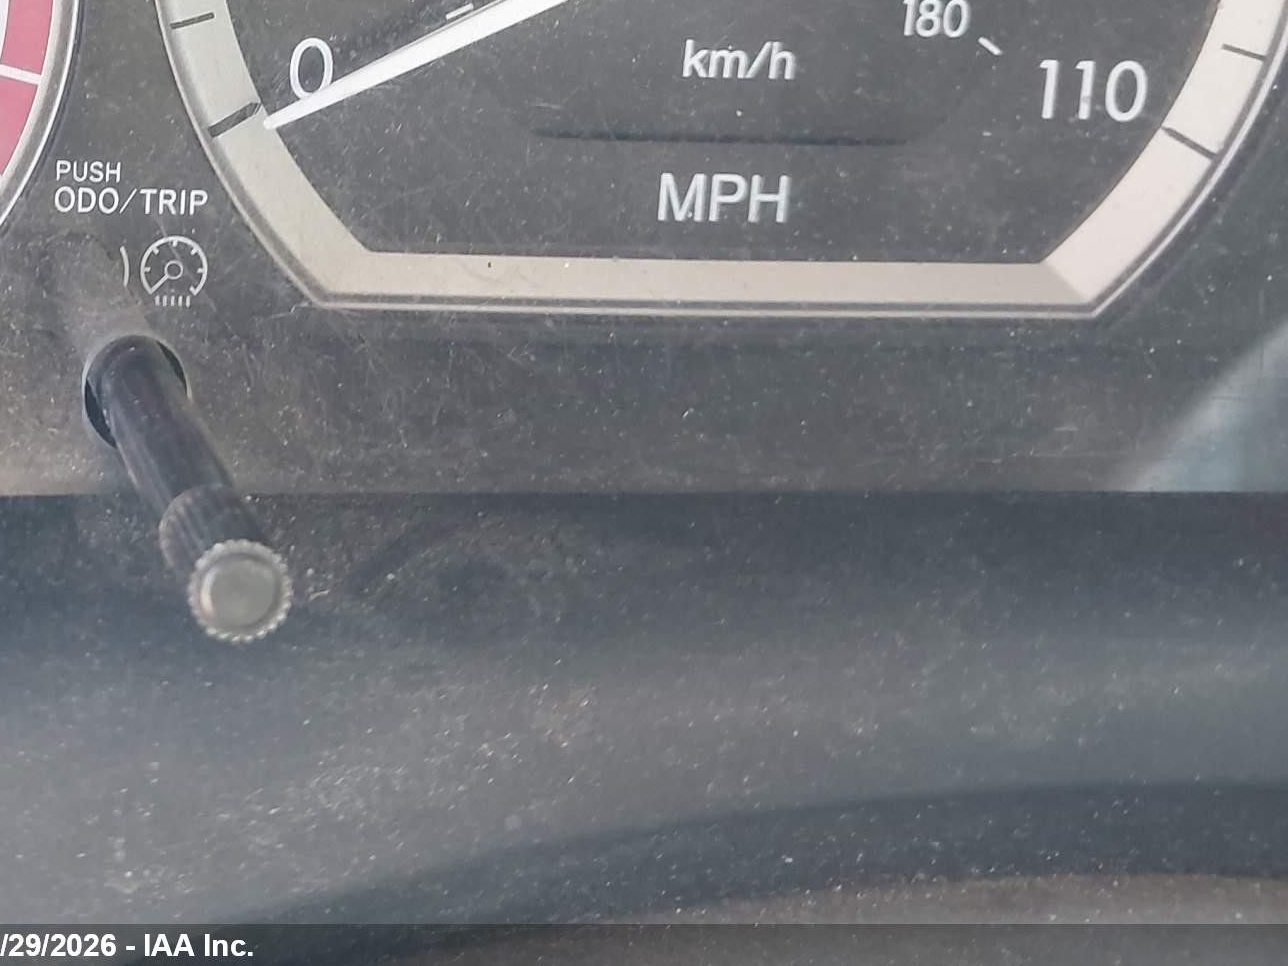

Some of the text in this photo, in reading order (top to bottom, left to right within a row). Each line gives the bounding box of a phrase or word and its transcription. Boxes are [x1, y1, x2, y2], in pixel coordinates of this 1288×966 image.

[289, 37, 334, 98] 0
[682, 40, 796, 81] km/h
[1039, 59, 1149, 123] 110
[55, 160, 122, 183] PUSH
[54, 186, 208, 216] ODO/TRIP
[657, 172, 790, 223] MPH
